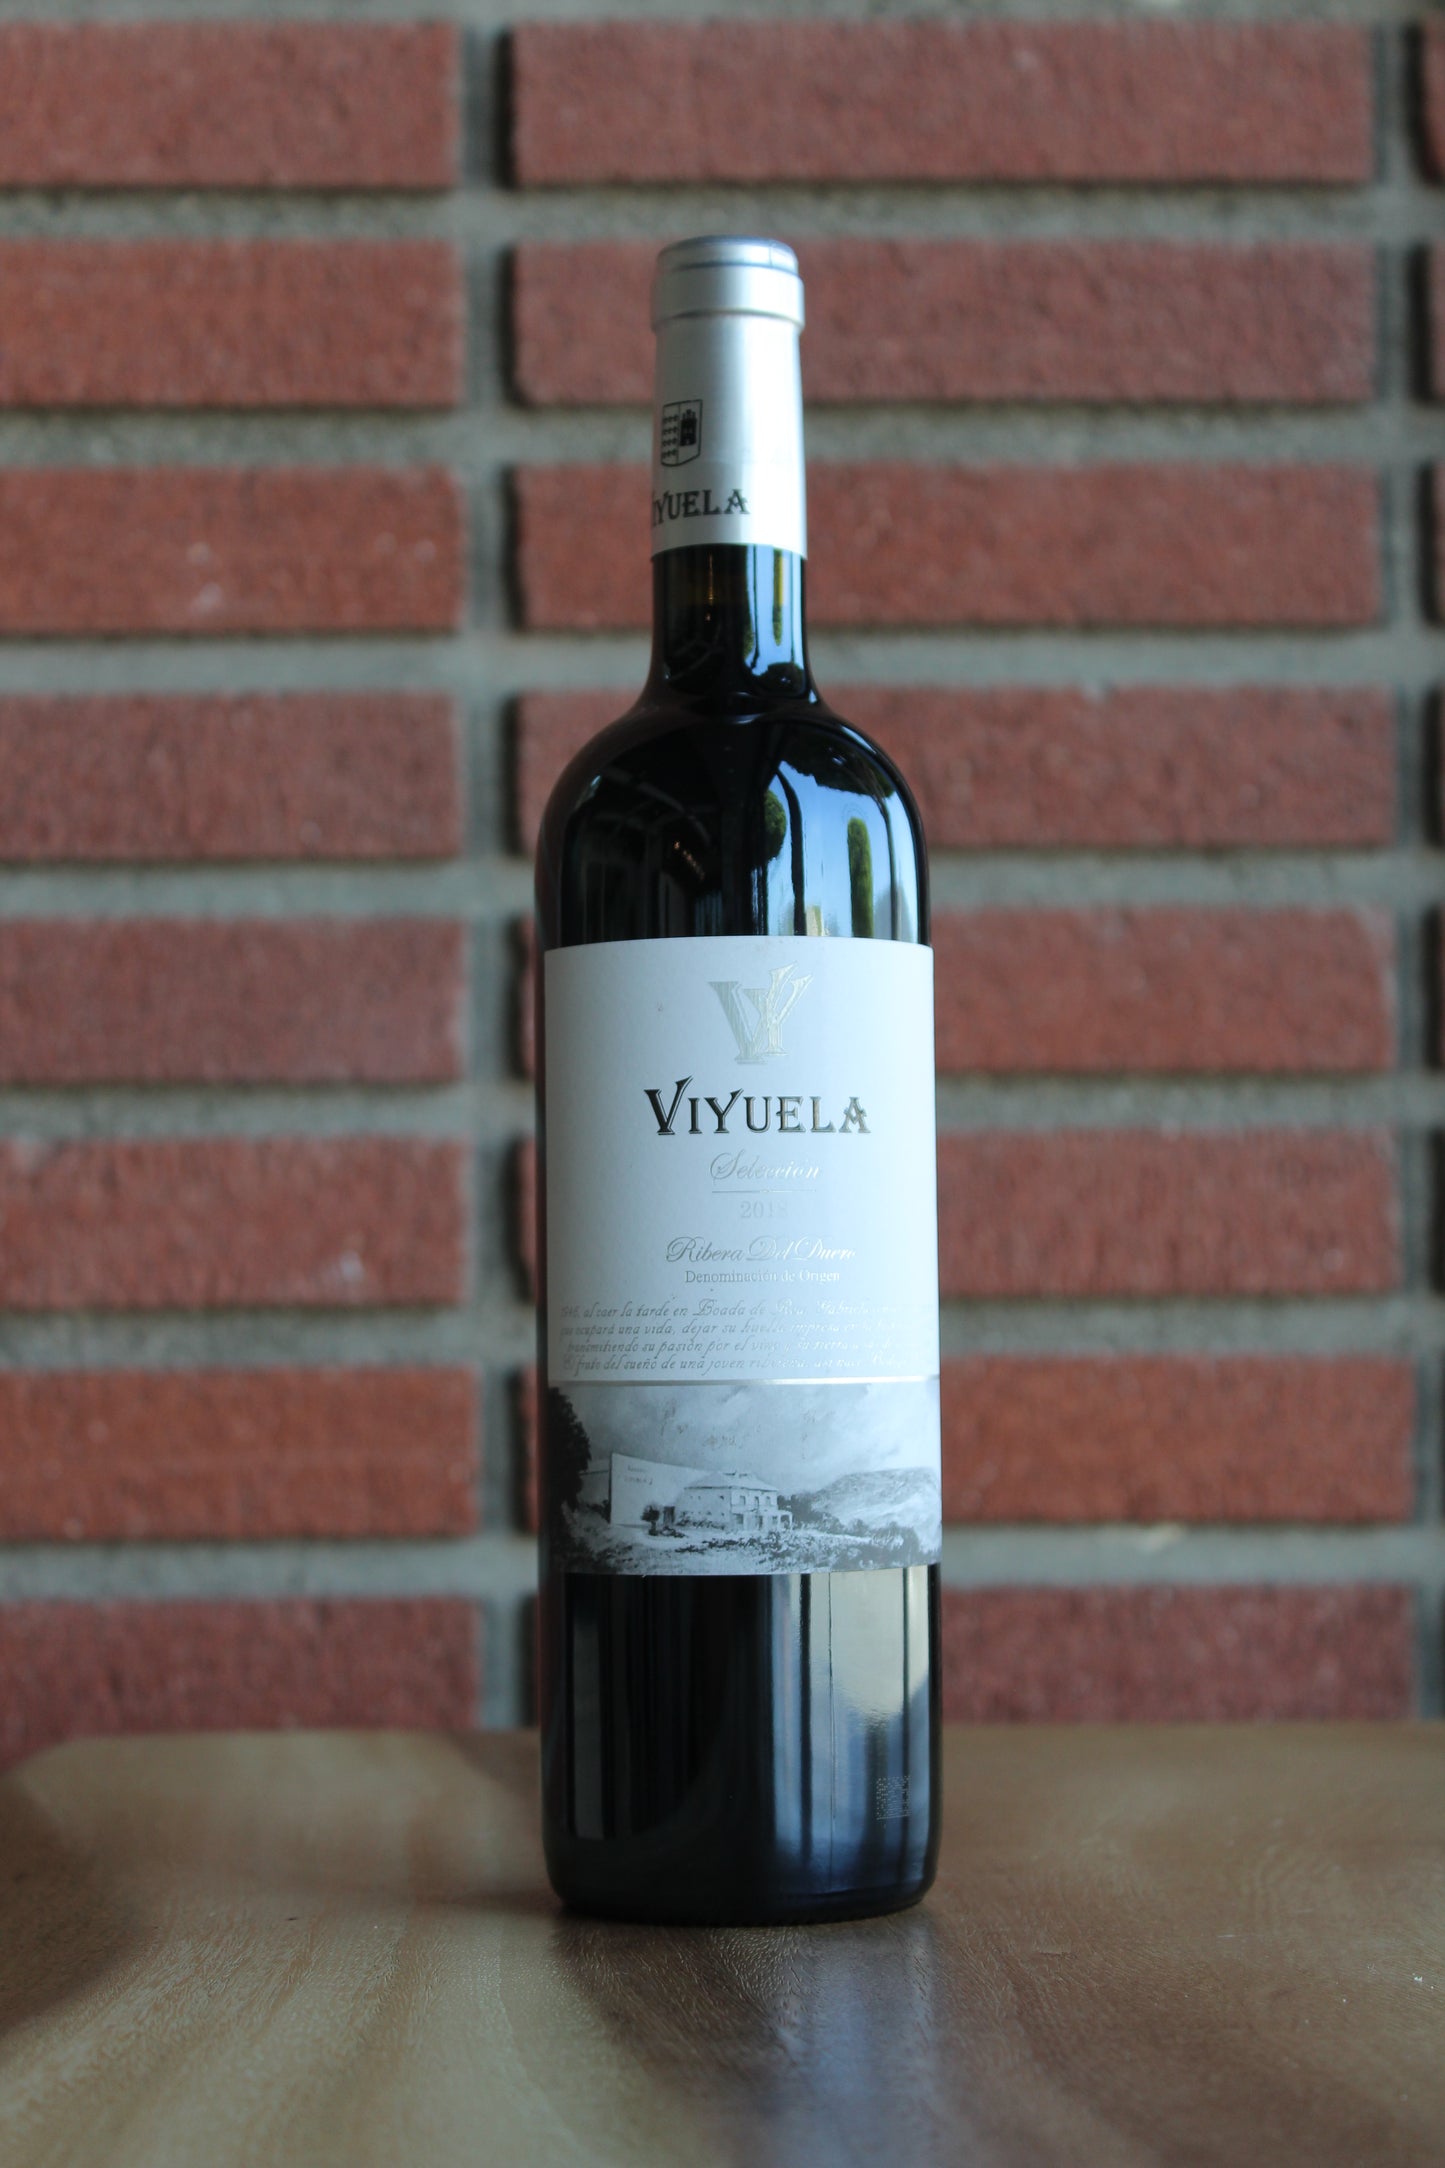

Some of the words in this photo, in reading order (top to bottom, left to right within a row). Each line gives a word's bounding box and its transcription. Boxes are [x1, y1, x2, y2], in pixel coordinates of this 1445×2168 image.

[652, 488, 750, 527] IYUELA
[643, 1075, 871, 1135] VIYUELA
[665, 1236, 744, 1262] Ribera
[685, 1269, 777, 1283] Denominación
[781, 1270, 797, 1283] de
[799, 1269, 840, 1287] Origen
[620, 1301, 632, 1317] la
[636, 1301, 670, 1317] tarde
[673, 1307, 688, 1316] en
[692, 1298, 746, 1316] Boada
[749, 1299, 767, 1316] de
[618, 1326, 640, 1335] una
[644, 1319, 676, 1336] vida,
[682, 1319, 720, 1342] dejar
[721, 1325, 737, 1334] su
[642, 1344, 655, 1353] su
[654, 1340, 703, 1359] pasión
[701, 1341, 731, 1359] por
[734, 1335, 756, 1352] el
[604, 1354, 629, 1370] del
[623, 1358, 657, 1370] sueño
[661, 1354, 677, 1369] de
[680, 1360, 705, 1369] una
[701, 1360, 745, 1376] joven
